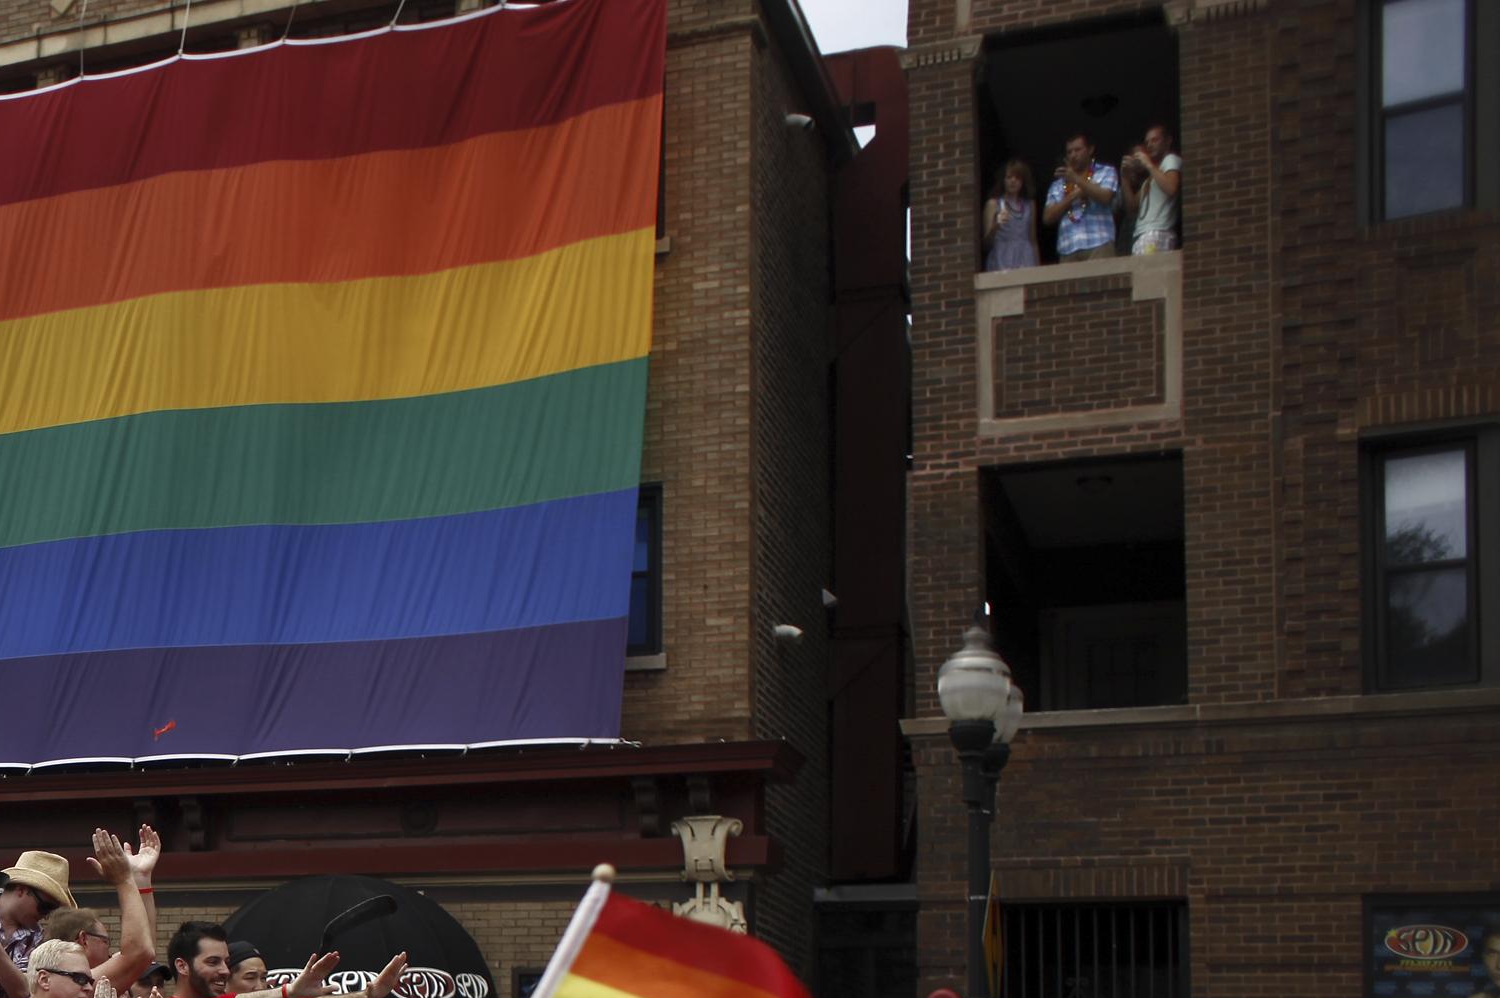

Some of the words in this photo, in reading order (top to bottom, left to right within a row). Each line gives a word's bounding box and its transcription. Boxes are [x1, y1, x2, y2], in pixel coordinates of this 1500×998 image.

[1399, 928, 1455, 956] SPIN
[328, 971, 380, 995] SPI
[400, 971, 447, 998] SPIN
[456, 973, 489, 998] SPIN
